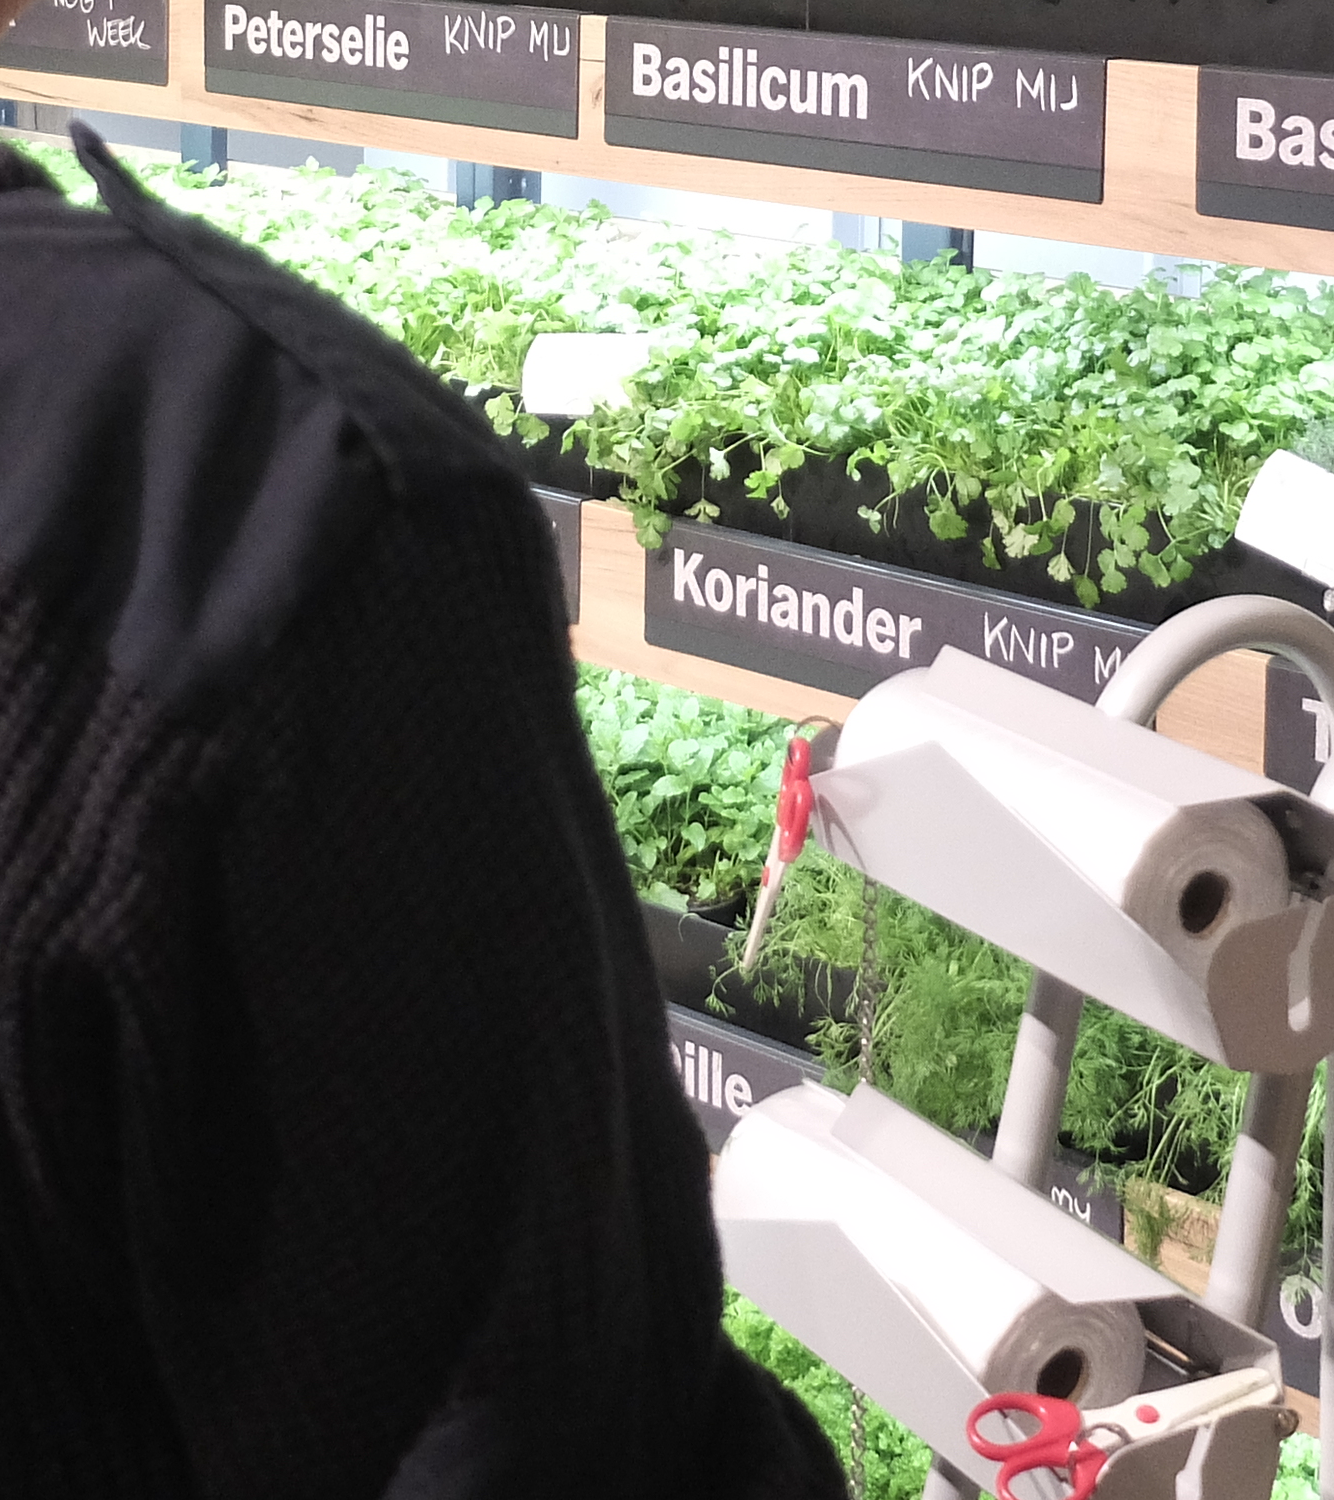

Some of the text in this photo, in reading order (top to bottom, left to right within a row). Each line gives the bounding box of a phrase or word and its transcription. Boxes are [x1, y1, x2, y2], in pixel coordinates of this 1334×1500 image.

[87, 15, 152, 50] WEEK
[224, 4, 410, 71] Peterselie
[444, 10, 516, 54] KNIP
[632, 42, 868, 120] Basilicum
[907, 57, 994, 103] KNIP
[673, 547, 923, 658] Koriander
[984, 611, 1075, 668] KNIP
